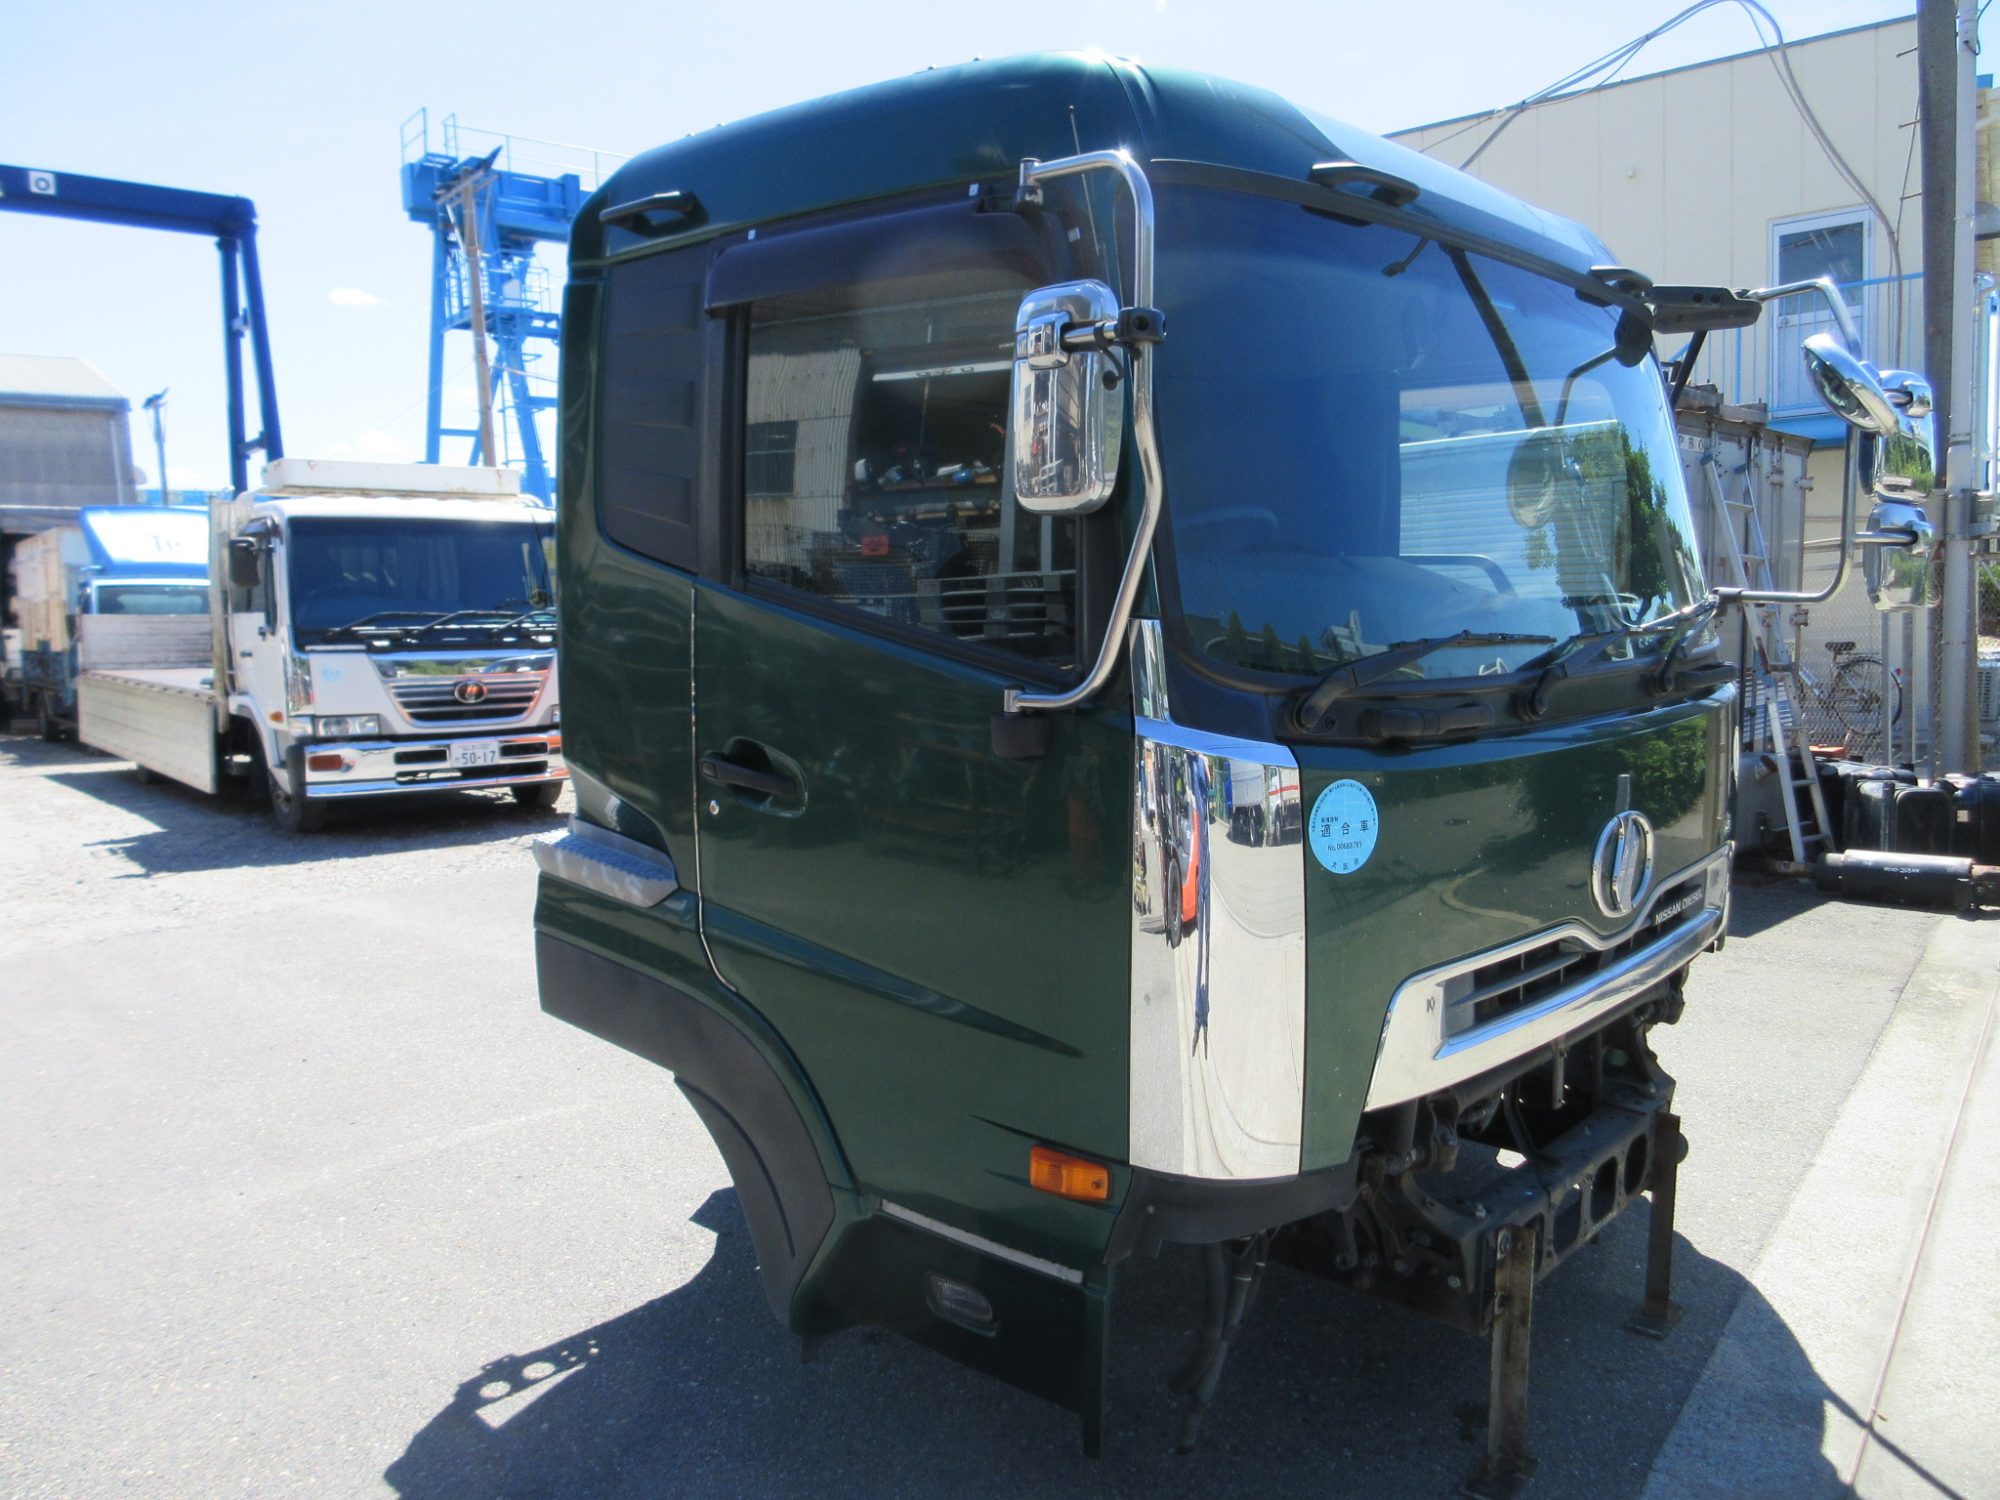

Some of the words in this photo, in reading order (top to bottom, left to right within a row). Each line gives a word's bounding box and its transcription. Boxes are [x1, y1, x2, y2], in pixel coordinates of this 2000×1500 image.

[461, 750, 496, 765] 50-17
[1320, 819, 1369, 838] 適合車
[1654, 900, 1682, 925] NISSAN
